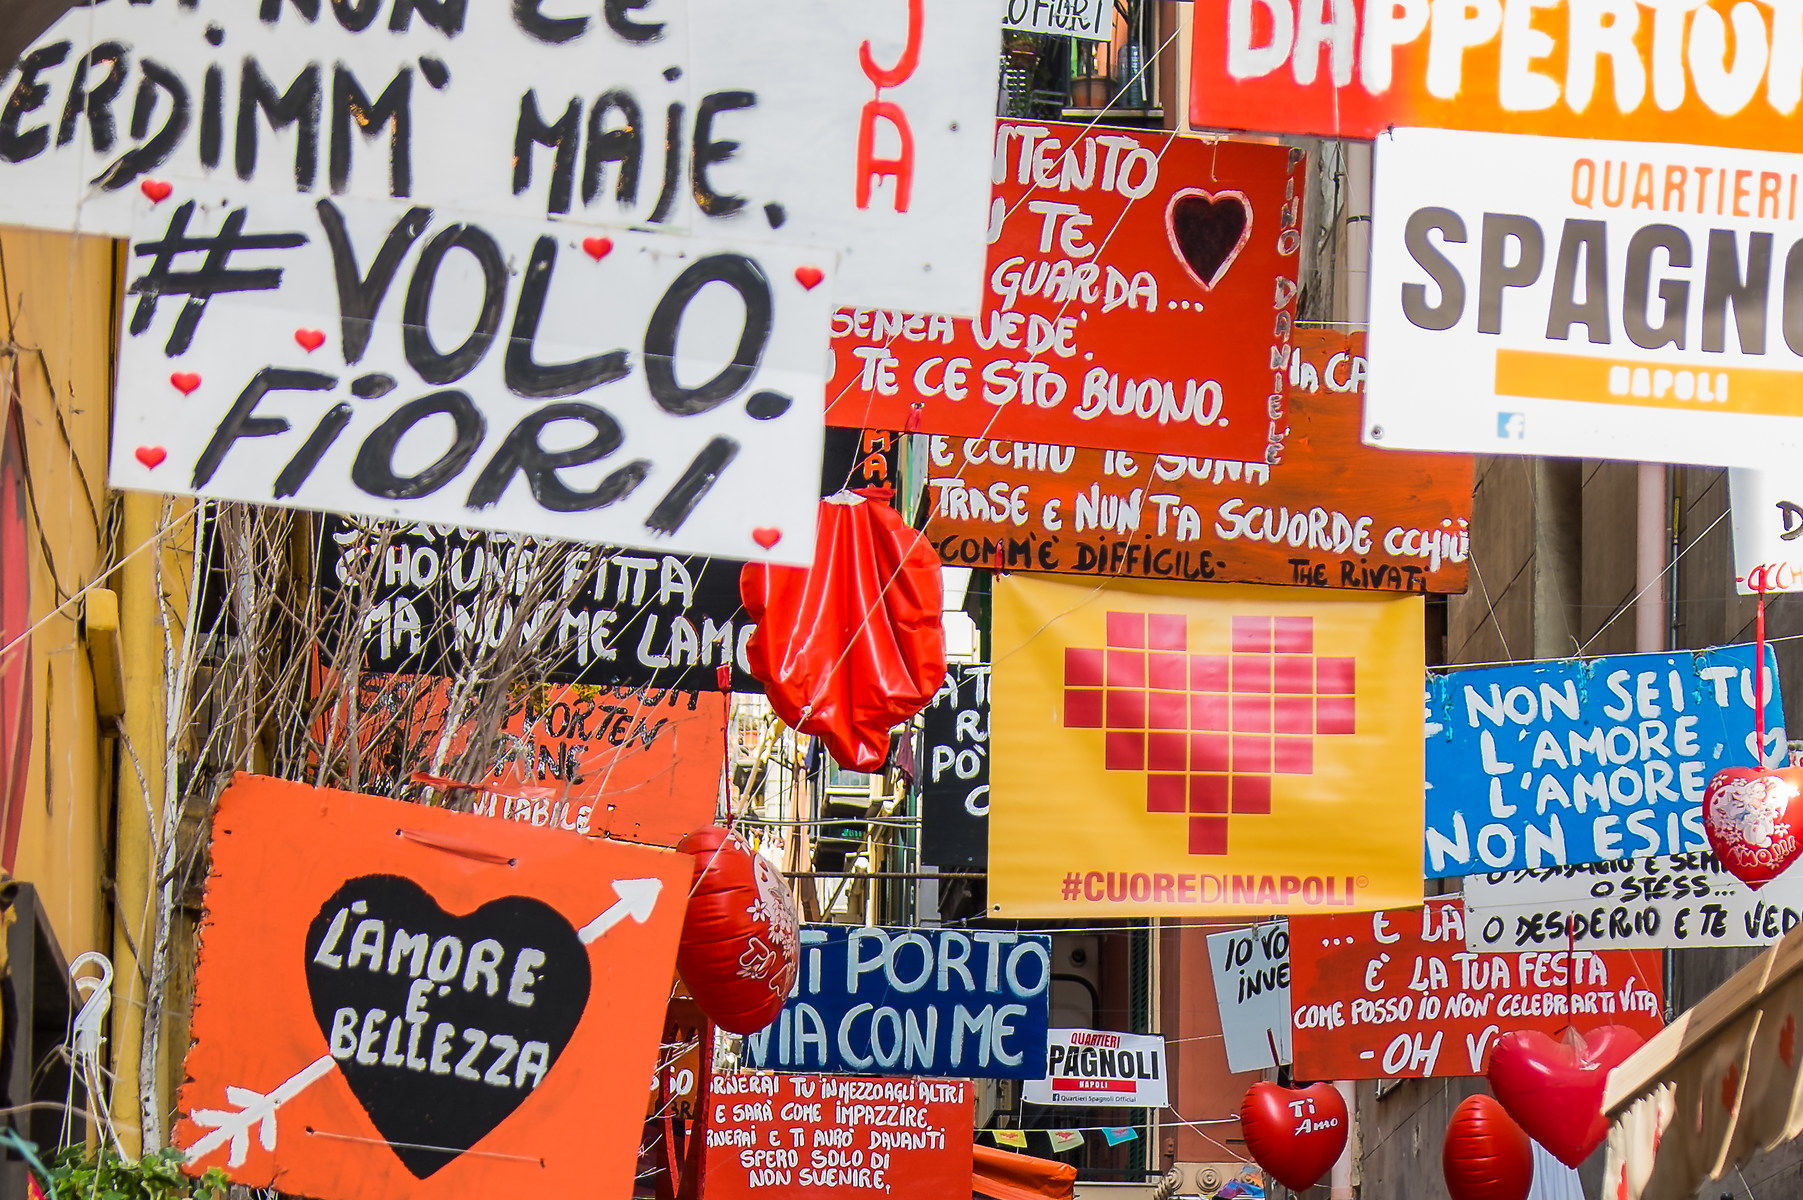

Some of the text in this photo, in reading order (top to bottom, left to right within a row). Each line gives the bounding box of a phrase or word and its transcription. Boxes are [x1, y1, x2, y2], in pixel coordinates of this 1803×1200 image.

[1571, 158, 1799, 220] QUARTIERI
[1028, 200, 1095, 258] TE
[852, 347, 900, 396] TE
[914, 357, 972, 402] CE
[982, 357, 1068, 408] STO
[1609, 366, 1728, 402] NAPOLI
[929, 477, 1029, 526] TRASE
[1043, 499, 1062, 531] E
[1075, 481, 1143, 535] NUN
[1215, 497, 1373, 554] SCUORDE
[562, 551, 693, 608] FITTA
[1289, 558, 1328, 586] THE
[558, 608, 618, 667] ME
[1463, 680, 1580, 727] NON
[1603, 658, 1685, 722] SEI
[1426, 805, 1568, 872] NON
[1482, 915, 1506, 944] O
[1674, 907, 1692, 940] E
[1699, 903, 1729, 938] TE
[847, 927, 1050, 998] PORTO
[1407, 956, 1450, 990] LA
[1451, 951, 1511, 990] TUA
[1518, 952, 1608, 988] FESTA
[1293, 1001, 1346, 1031] COME
[1351, 994, 1414, 1026] POSSO
[1444, 992, 1495, 1019] NON
[1618, 975, 1659, 1018] VITA
[329, 1007, 551, 1089] BELLEZZA
[838, 1002, 938, 1069] CON
[950, 1003, 1028, 1068] ME
[1070, 1032, 1120, 1049] QUARTIERI
[1049, 1044, 1159, 1080] PAGNOLI
[710, 1075, 780, 1097] RNERAI
[789, 1077, 816, 1098] TU
[918, 1081, 964, 1105] ALTRI
[1060, 1094, 1088, 1102] Quartieri
[1088, 1095, 1115, 1104] Spagnoli
[1079, 1080, 1108, 1089] NAPOLI
[715, 1103, 726, 1124] E
[780, 1102, 822, 1123] COME
[1294, 1115, 1338, 1136] Amo
[768, 1129, 781, 1147] E
[788, 1127, 805, 1147] TI
[740, 1149, 890, 1170] SPERO SOLO DI
[749, 1168, 792, 1188] NON
